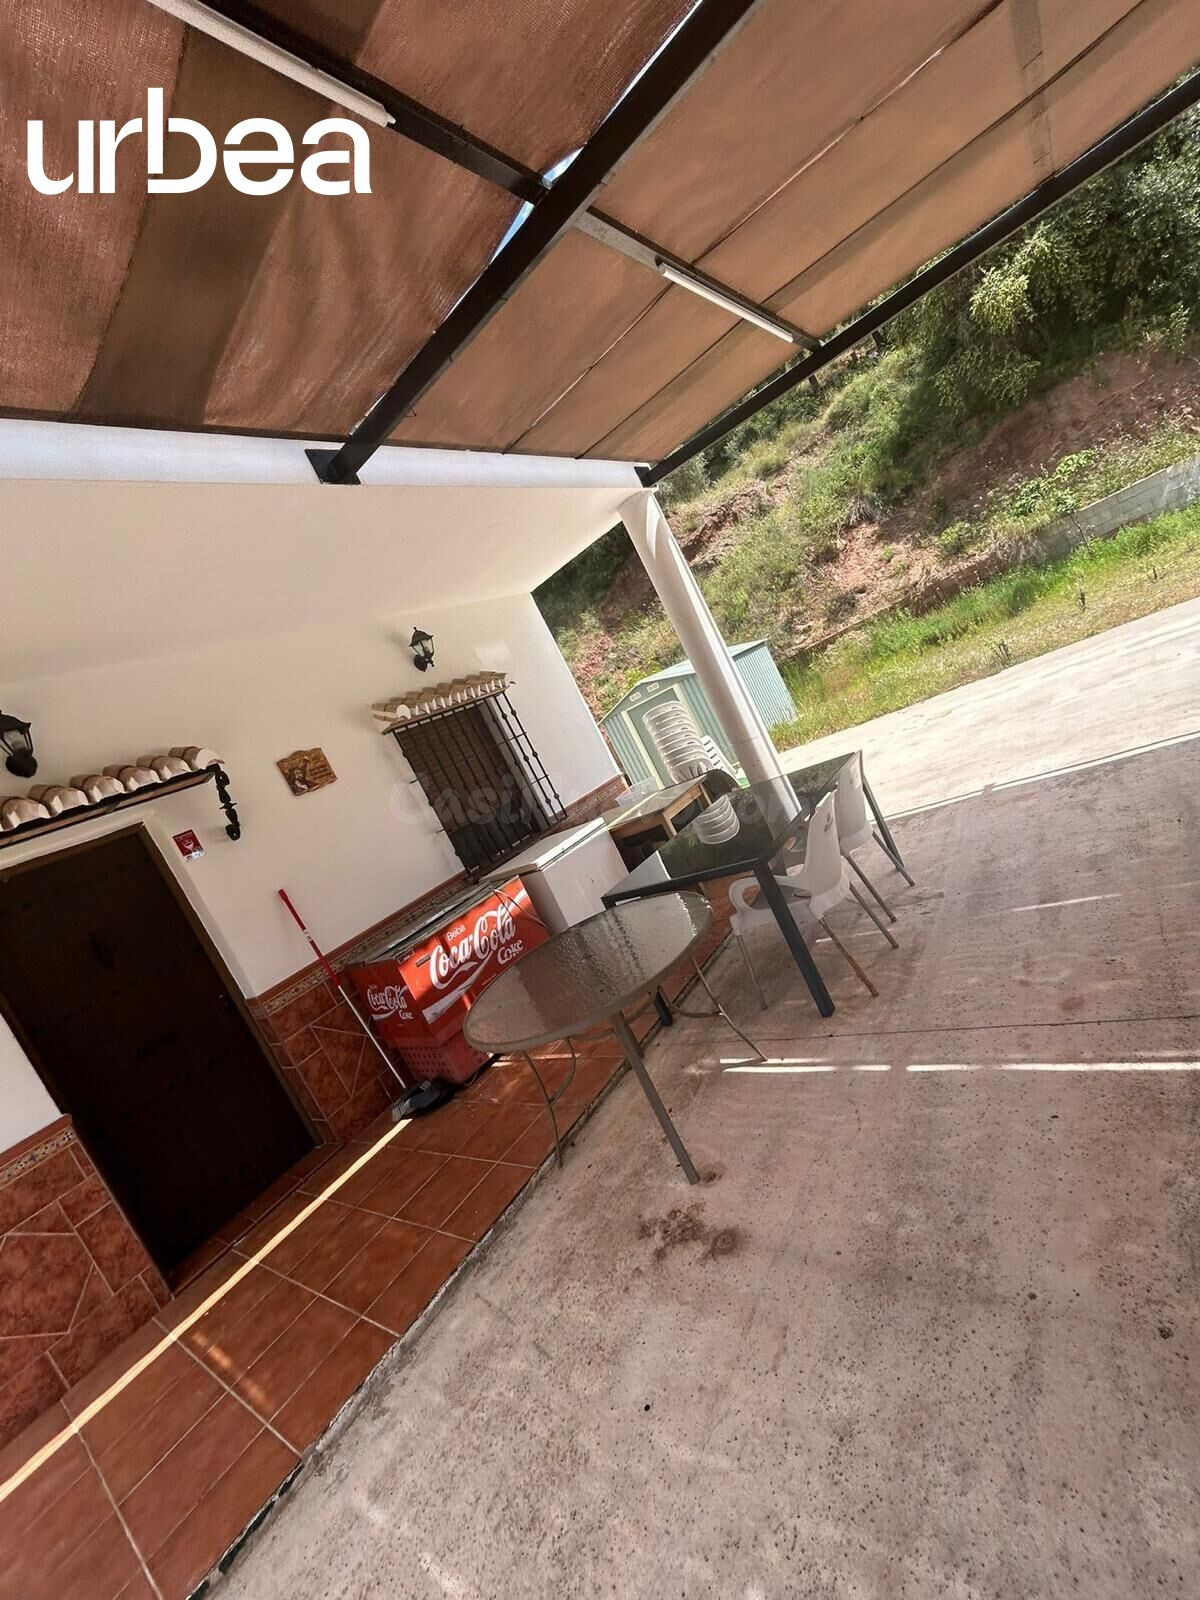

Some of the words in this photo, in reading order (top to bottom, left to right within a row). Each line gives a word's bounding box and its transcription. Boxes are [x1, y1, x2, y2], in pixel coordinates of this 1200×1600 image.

[446, 924, 466, 941] Beba
[429, 903, 517, 990] Coca-Cola
[497, 938, 524, 965] Coke
[367, 985, 408, 1012] Coca-Cola
